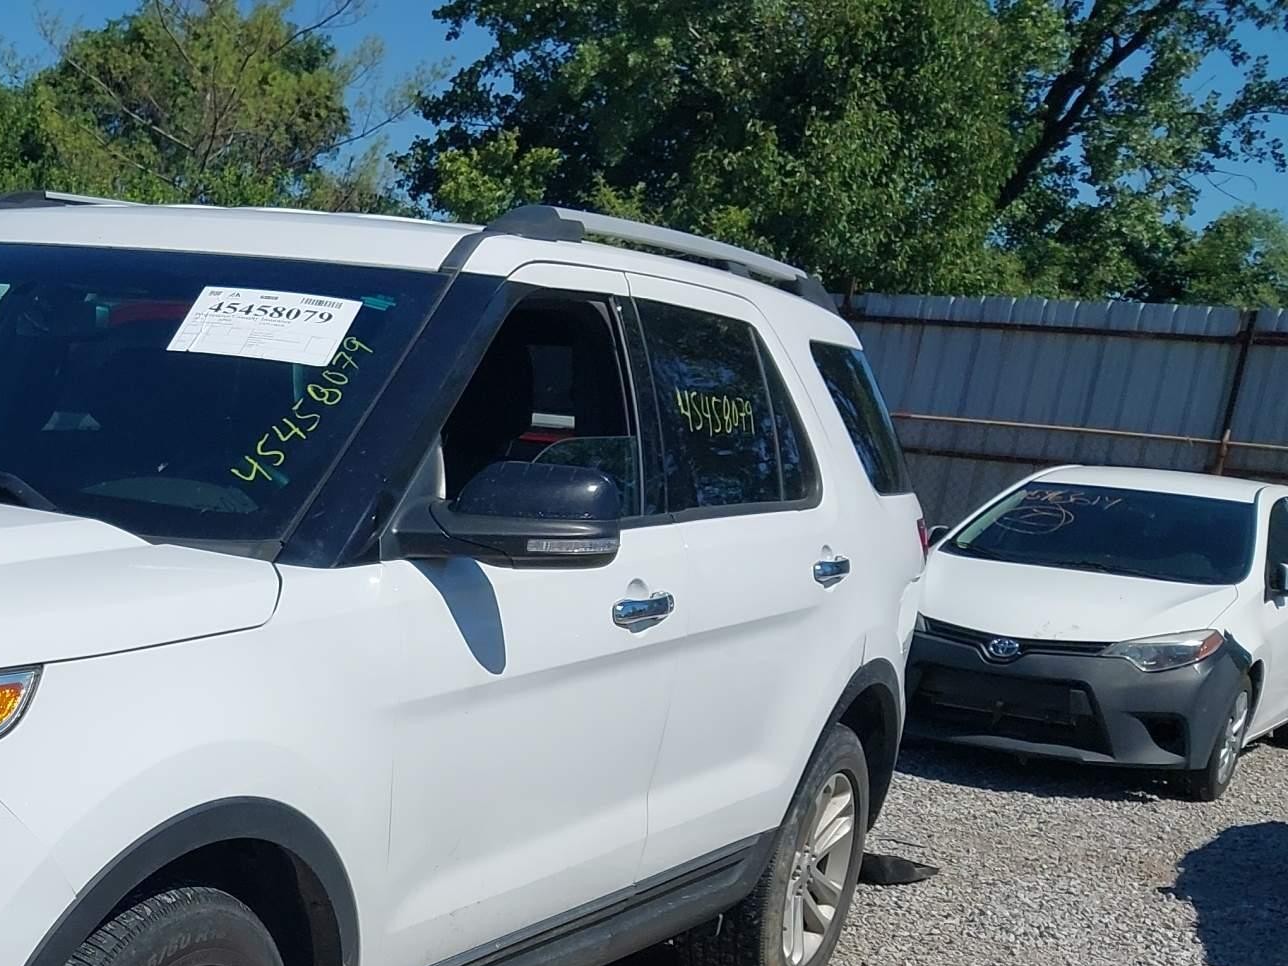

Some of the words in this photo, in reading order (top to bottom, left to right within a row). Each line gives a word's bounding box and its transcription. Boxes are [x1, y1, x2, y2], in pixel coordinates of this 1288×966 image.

[208, 301, 334, 324] 45458079
[230, 336, 374, 482] 45458079
[675, 387, 755, 436] 45458079
